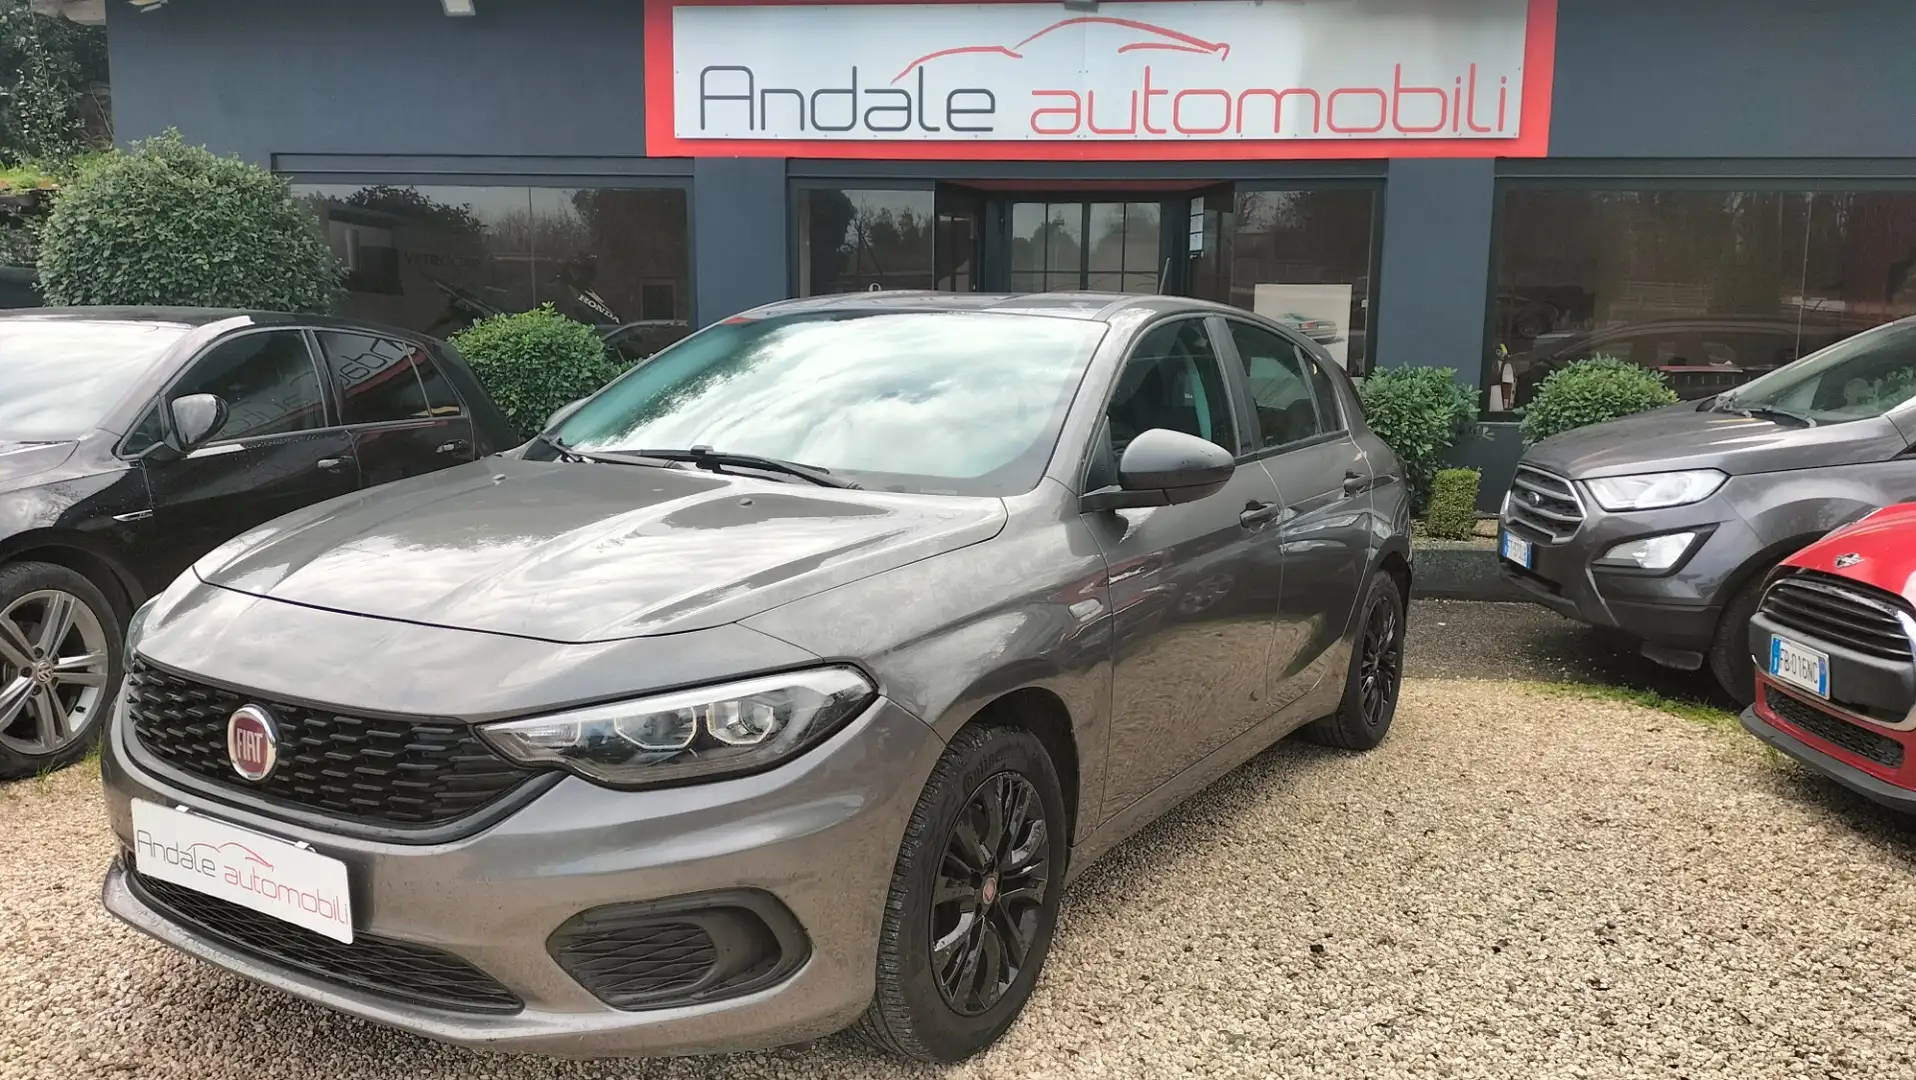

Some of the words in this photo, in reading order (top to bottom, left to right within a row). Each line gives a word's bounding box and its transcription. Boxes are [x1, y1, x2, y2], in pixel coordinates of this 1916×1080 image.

[700, 66, 996, 132] Andale
[1031, 64, 1505, 135] automobili
[578, 294, 620, 324] HONDA
[236, 728, 263, 763] FIAT
[137, 830, 216, 877] Andale
[224, 865, 349, 926] automobili
